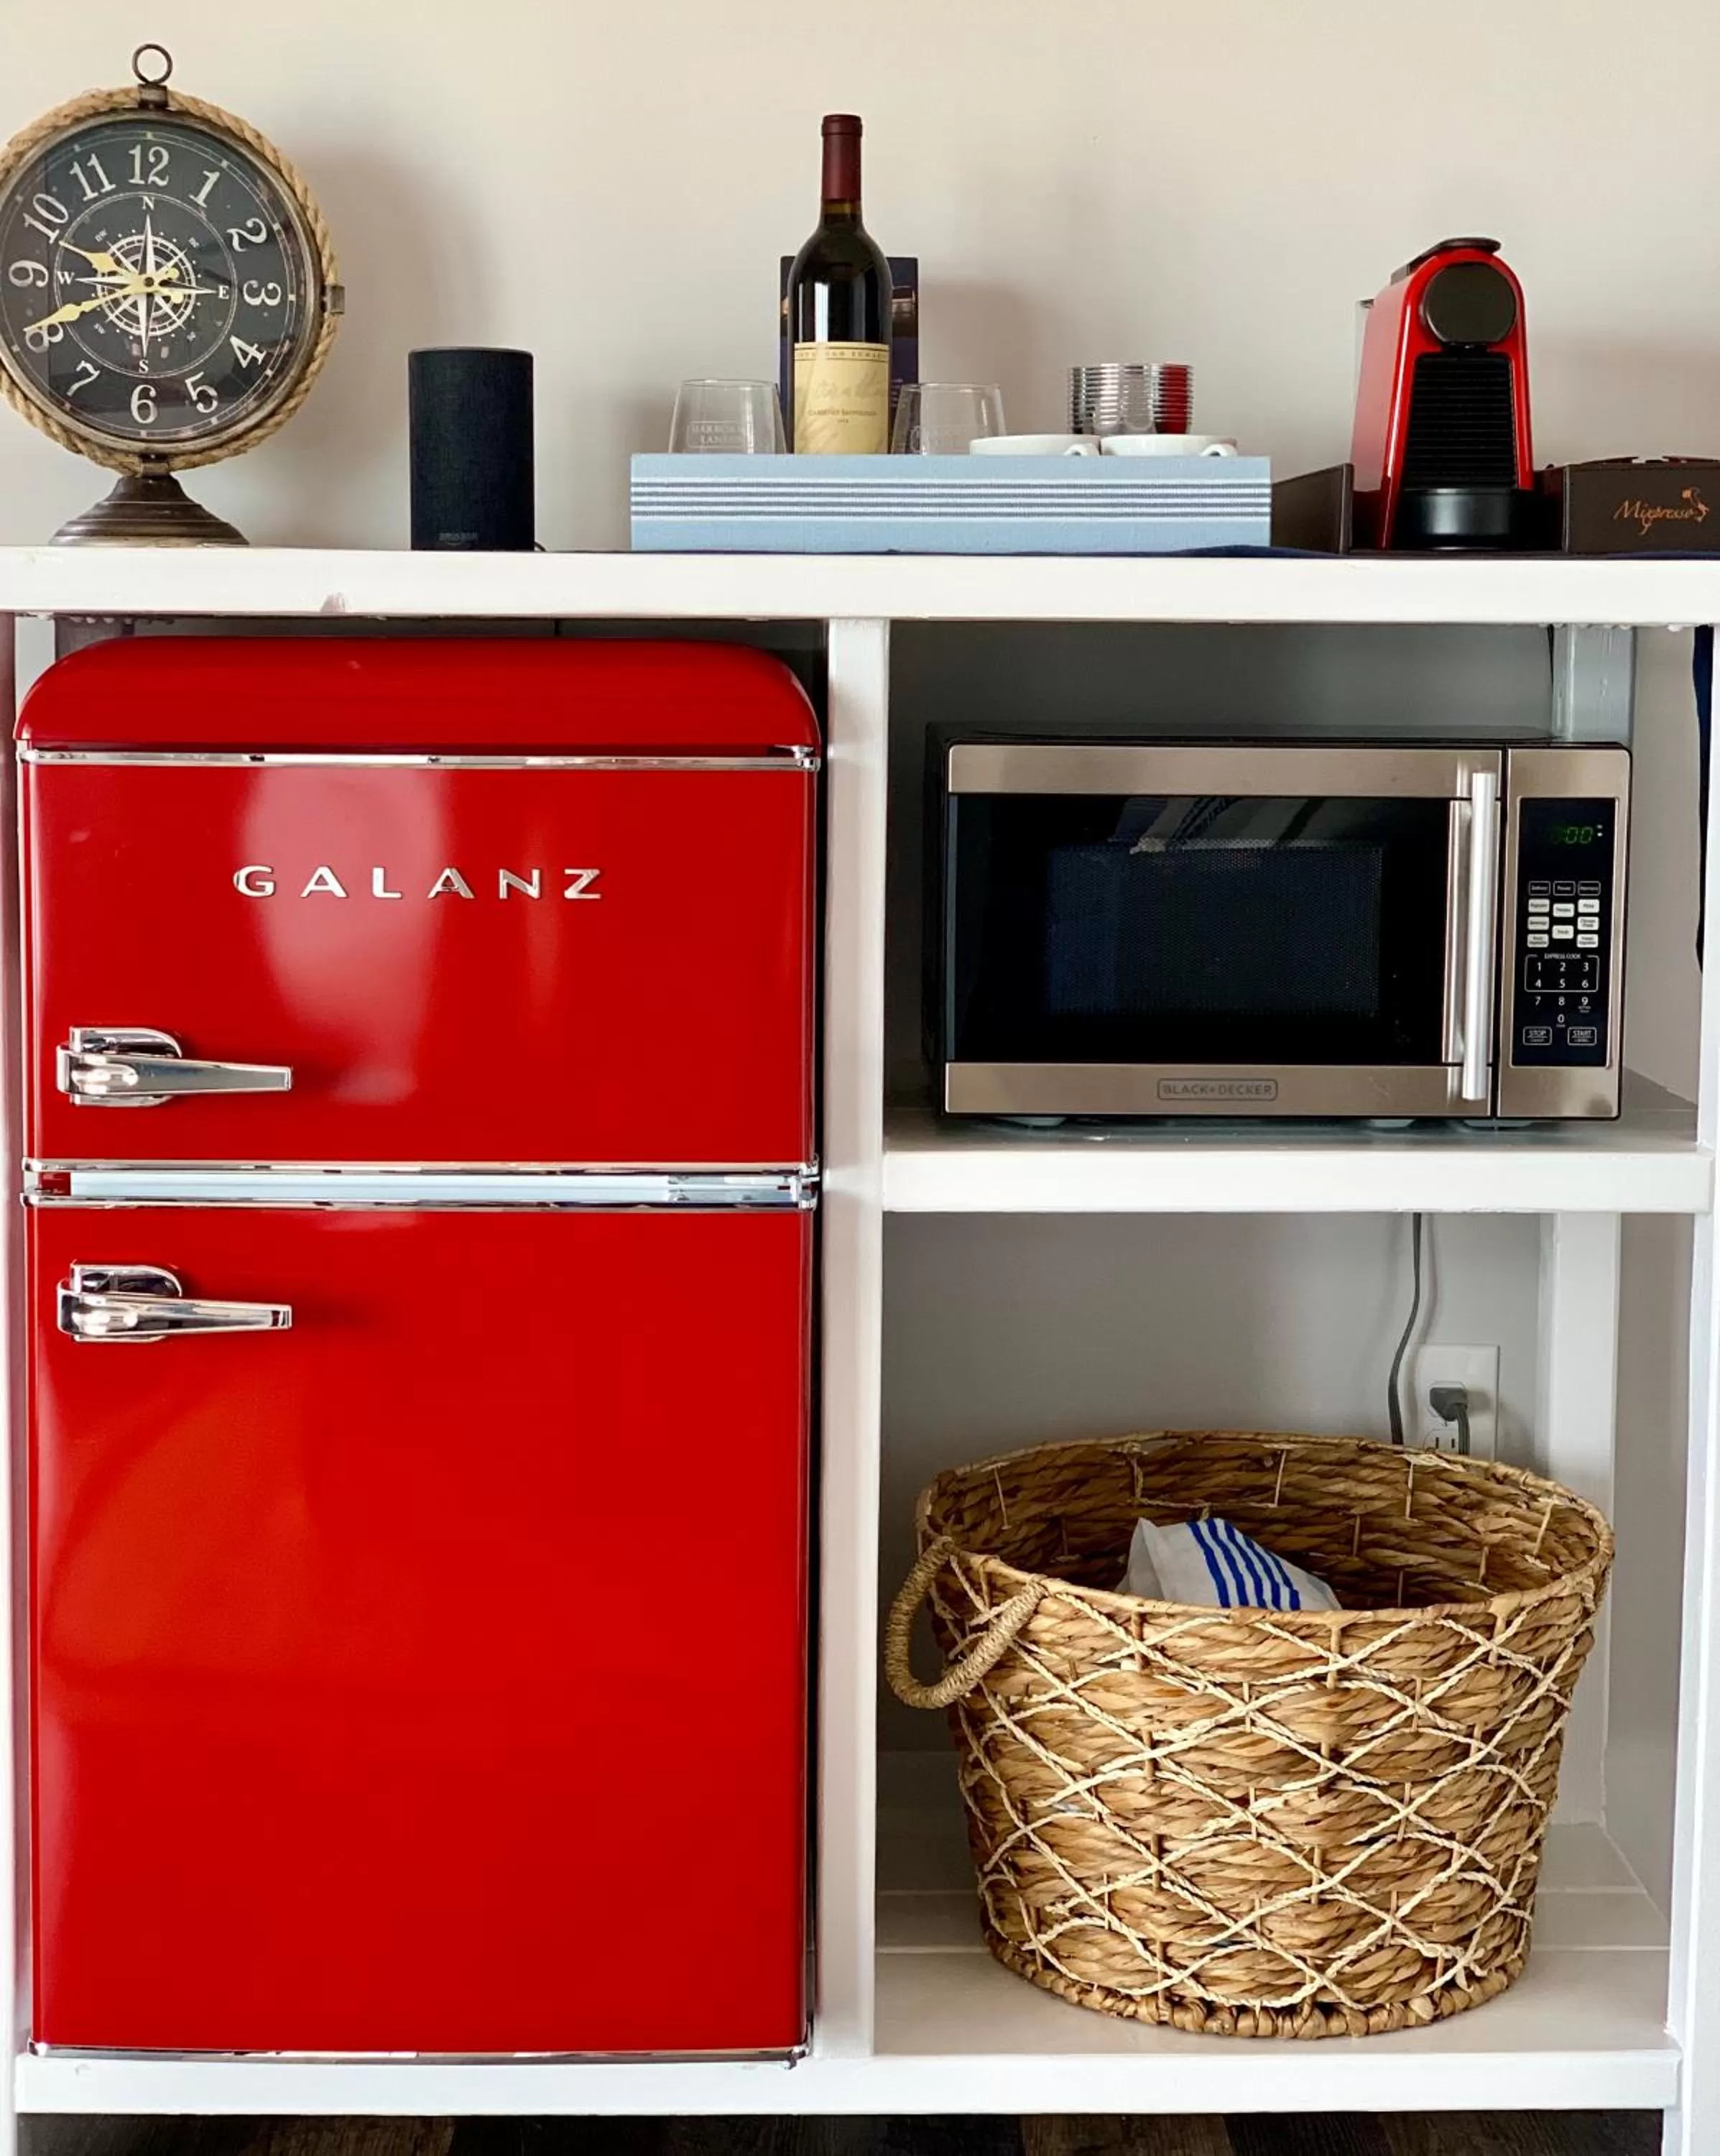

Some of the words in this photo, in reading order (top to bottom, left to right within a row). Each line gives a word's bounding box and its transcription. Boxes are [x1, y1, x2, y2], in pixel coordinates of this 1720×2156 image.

[69, 153, 116, 202] 11
[127, 144, 170, 187] 12
[142, 195, 155, 210] N
[188, 170, 220, 208] 1
[23, 193, 70, 244] 10
[227, 217, 267, 252] 2
[9, 259, 50, 287] 9
[57, 271, 75, 285] W
[218, 285, 230, 299] E
[243, 280, 281, 306] 3
[25, 321, 65, 354] 8
[229, 334, 267, 369] 4
[67, 361, 100, 396] 7
[139, 360, 149, 374] S
[130, 384, 157, 424] 6
[184, 372, 218, 414] 5
[233, 865, 601, 898] GALANZ
[1535, 979, 1542, 988] 4
[1559, 979, 1566, 988] 5
[1581, 979, 1589, 988] 6
[1537, 962, 1542, 972] 1
[1560, 962, 1566, 972] 2
[1583, 962, 1589, 972] 3
[1535, 996, 1542, 1005] 7
[1558, 996, 1566, 1005] 8
[1581, 996, 1589, 1005] 9
[1557, 1014, 1565, 1023] 0
